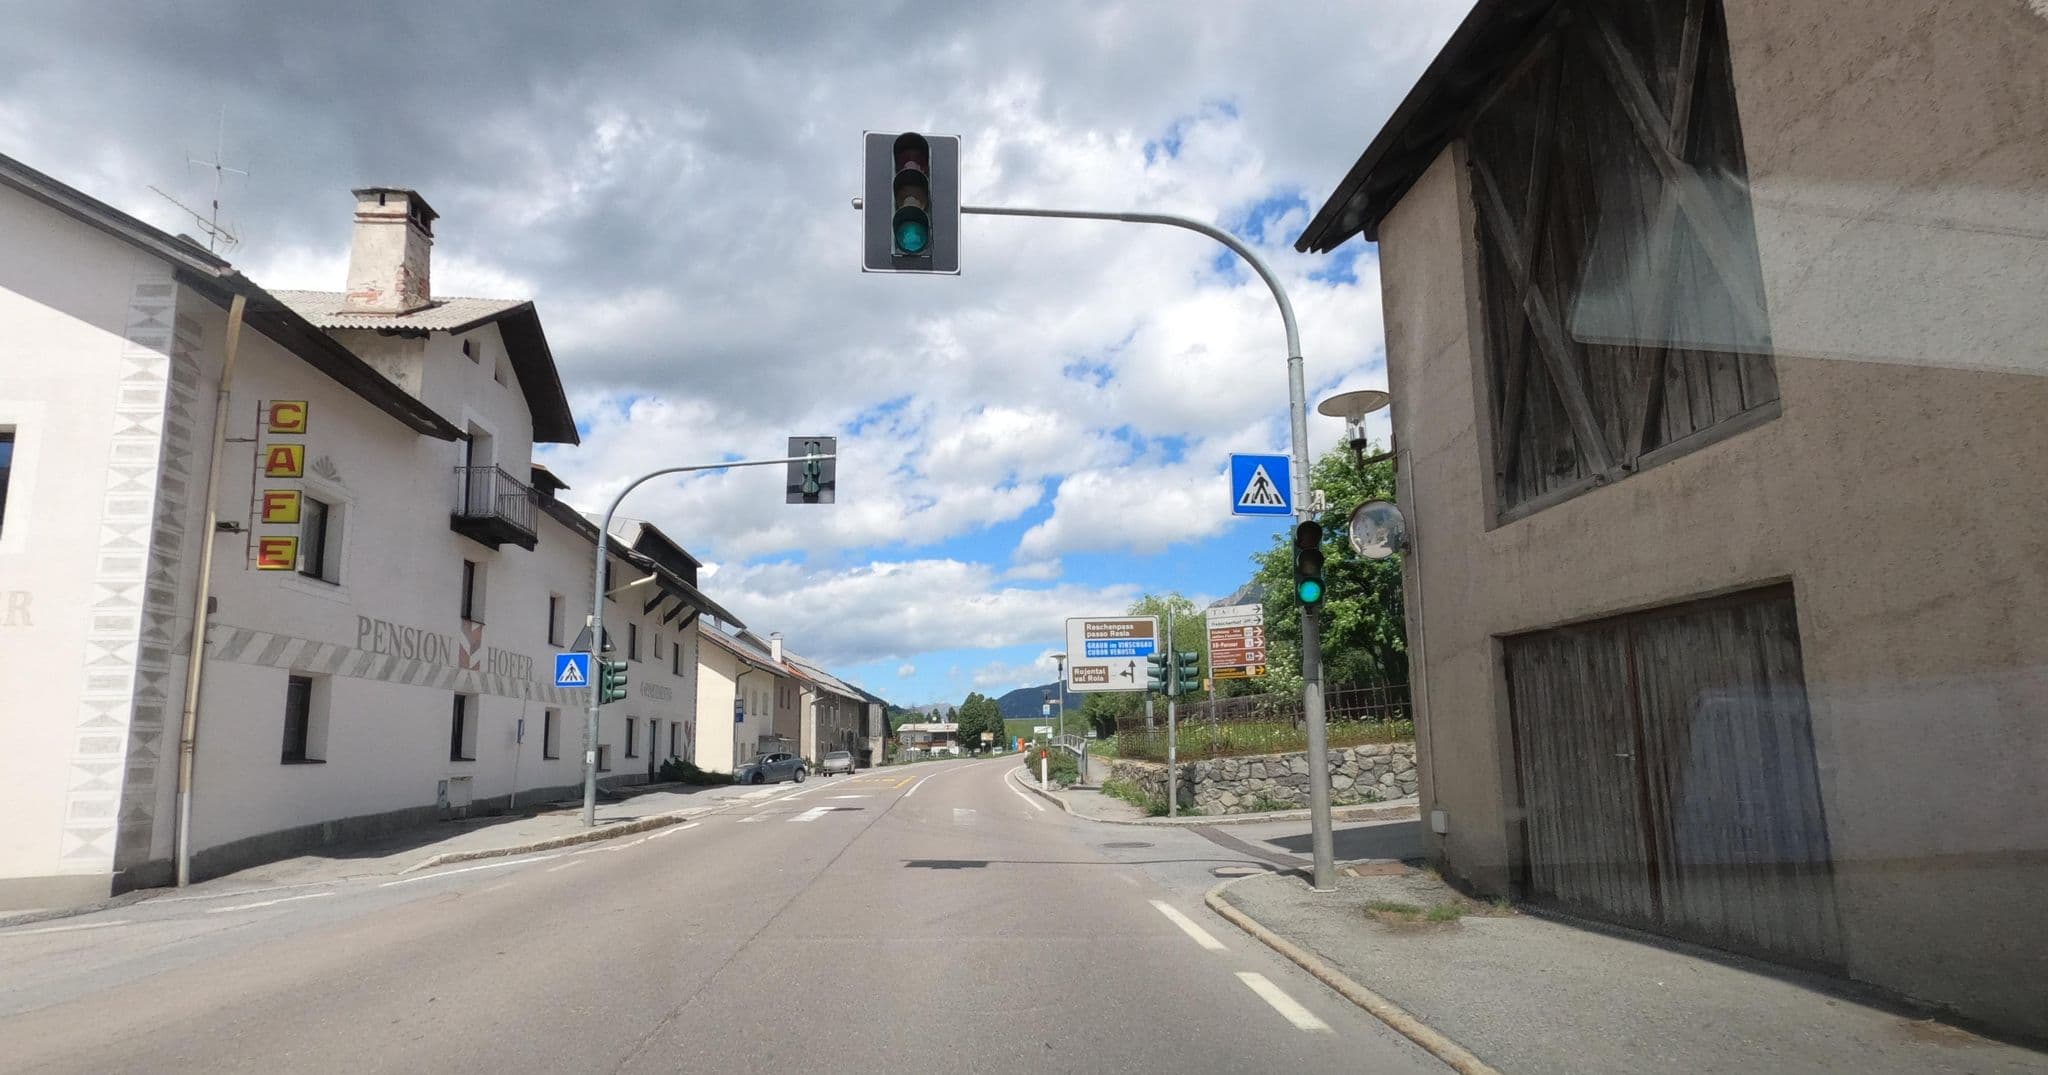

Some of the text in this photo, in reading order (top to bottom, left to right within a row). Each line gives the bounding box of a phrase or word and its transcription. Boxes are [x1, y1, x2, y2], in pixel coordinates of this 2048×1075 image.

[258, 401, 302, 567] CAFE
[0, 590, 35, 626] R
[1086, 623, 1134, 631] Reschenpass
[356, 615, 534, 683] PENSION HOFER
[1087, 641, 1108, 649] GRAUN
[1110, 648, 1136, 656] VENOSTA
[1074, 667, 1106, 675] Rojental
